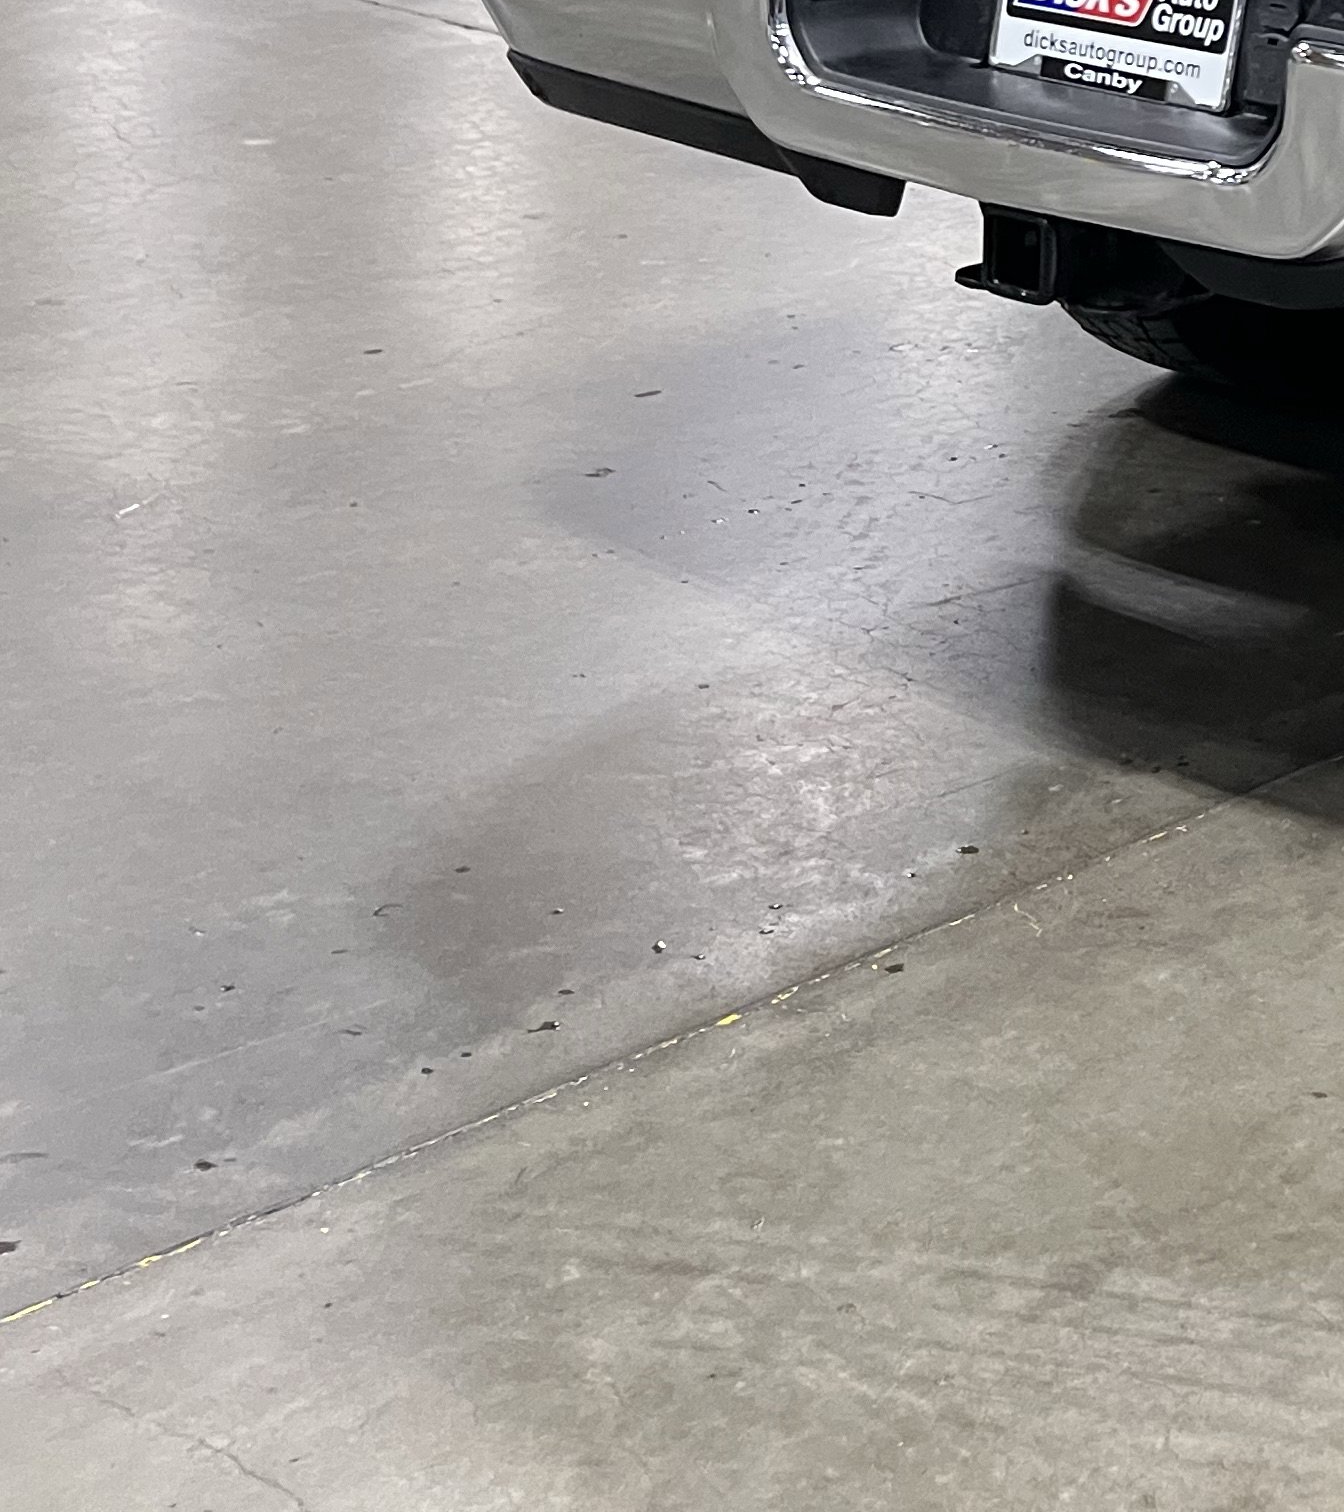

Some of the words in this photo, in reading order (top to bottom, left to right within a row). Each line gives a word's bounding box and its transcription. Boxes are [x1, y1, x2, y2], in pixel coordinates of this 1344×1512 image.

[1152, 3, 1225, 46] Group
[1023, 29, 1201, 79] dicksautogroup.com
[1064, 63, 1143, 94] Canby
